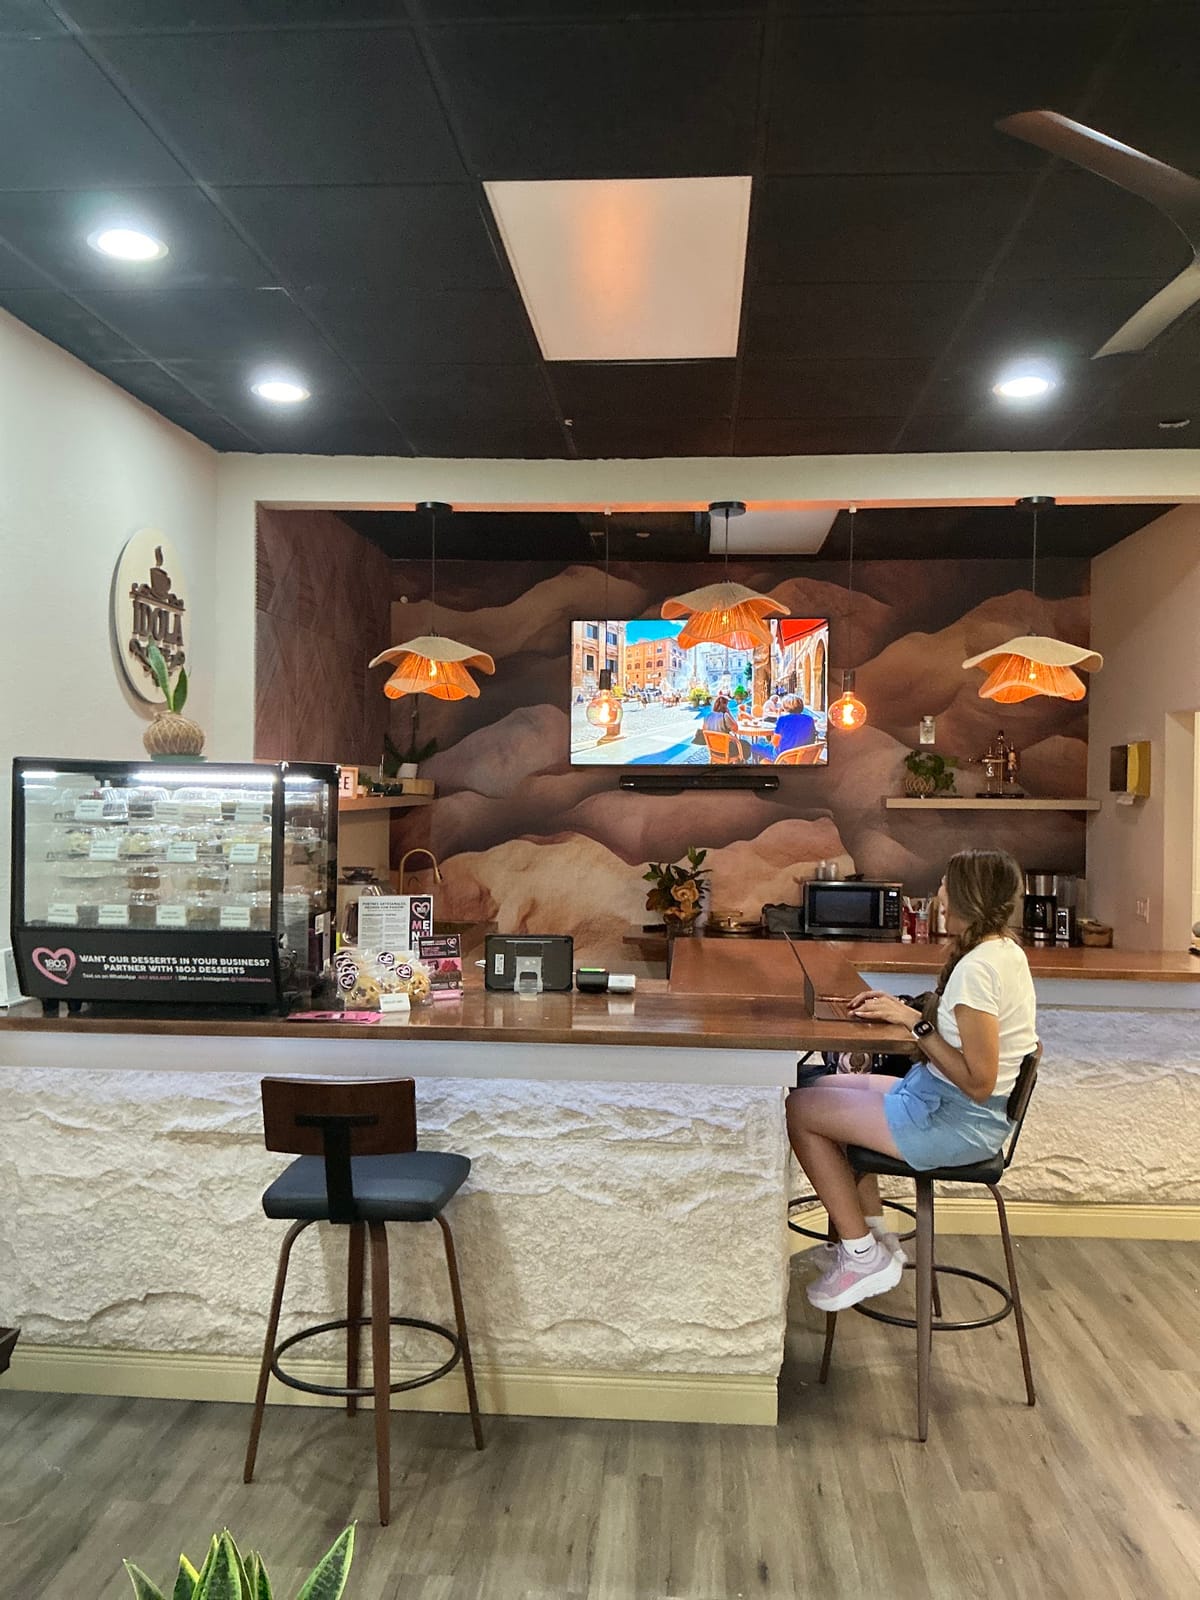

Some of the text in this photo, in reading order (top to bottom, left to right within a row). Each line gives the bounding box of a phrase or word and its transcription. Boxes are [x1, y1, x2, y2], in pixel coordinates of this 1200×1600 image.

[44, 958, 67, 968] 1803
[79, 954, 270, 967] WANT OUR DESSERTS IN YOUR BUSINESS?
[103, 963, 246, 974] PARTNER WITH 1803 DESSERTS
